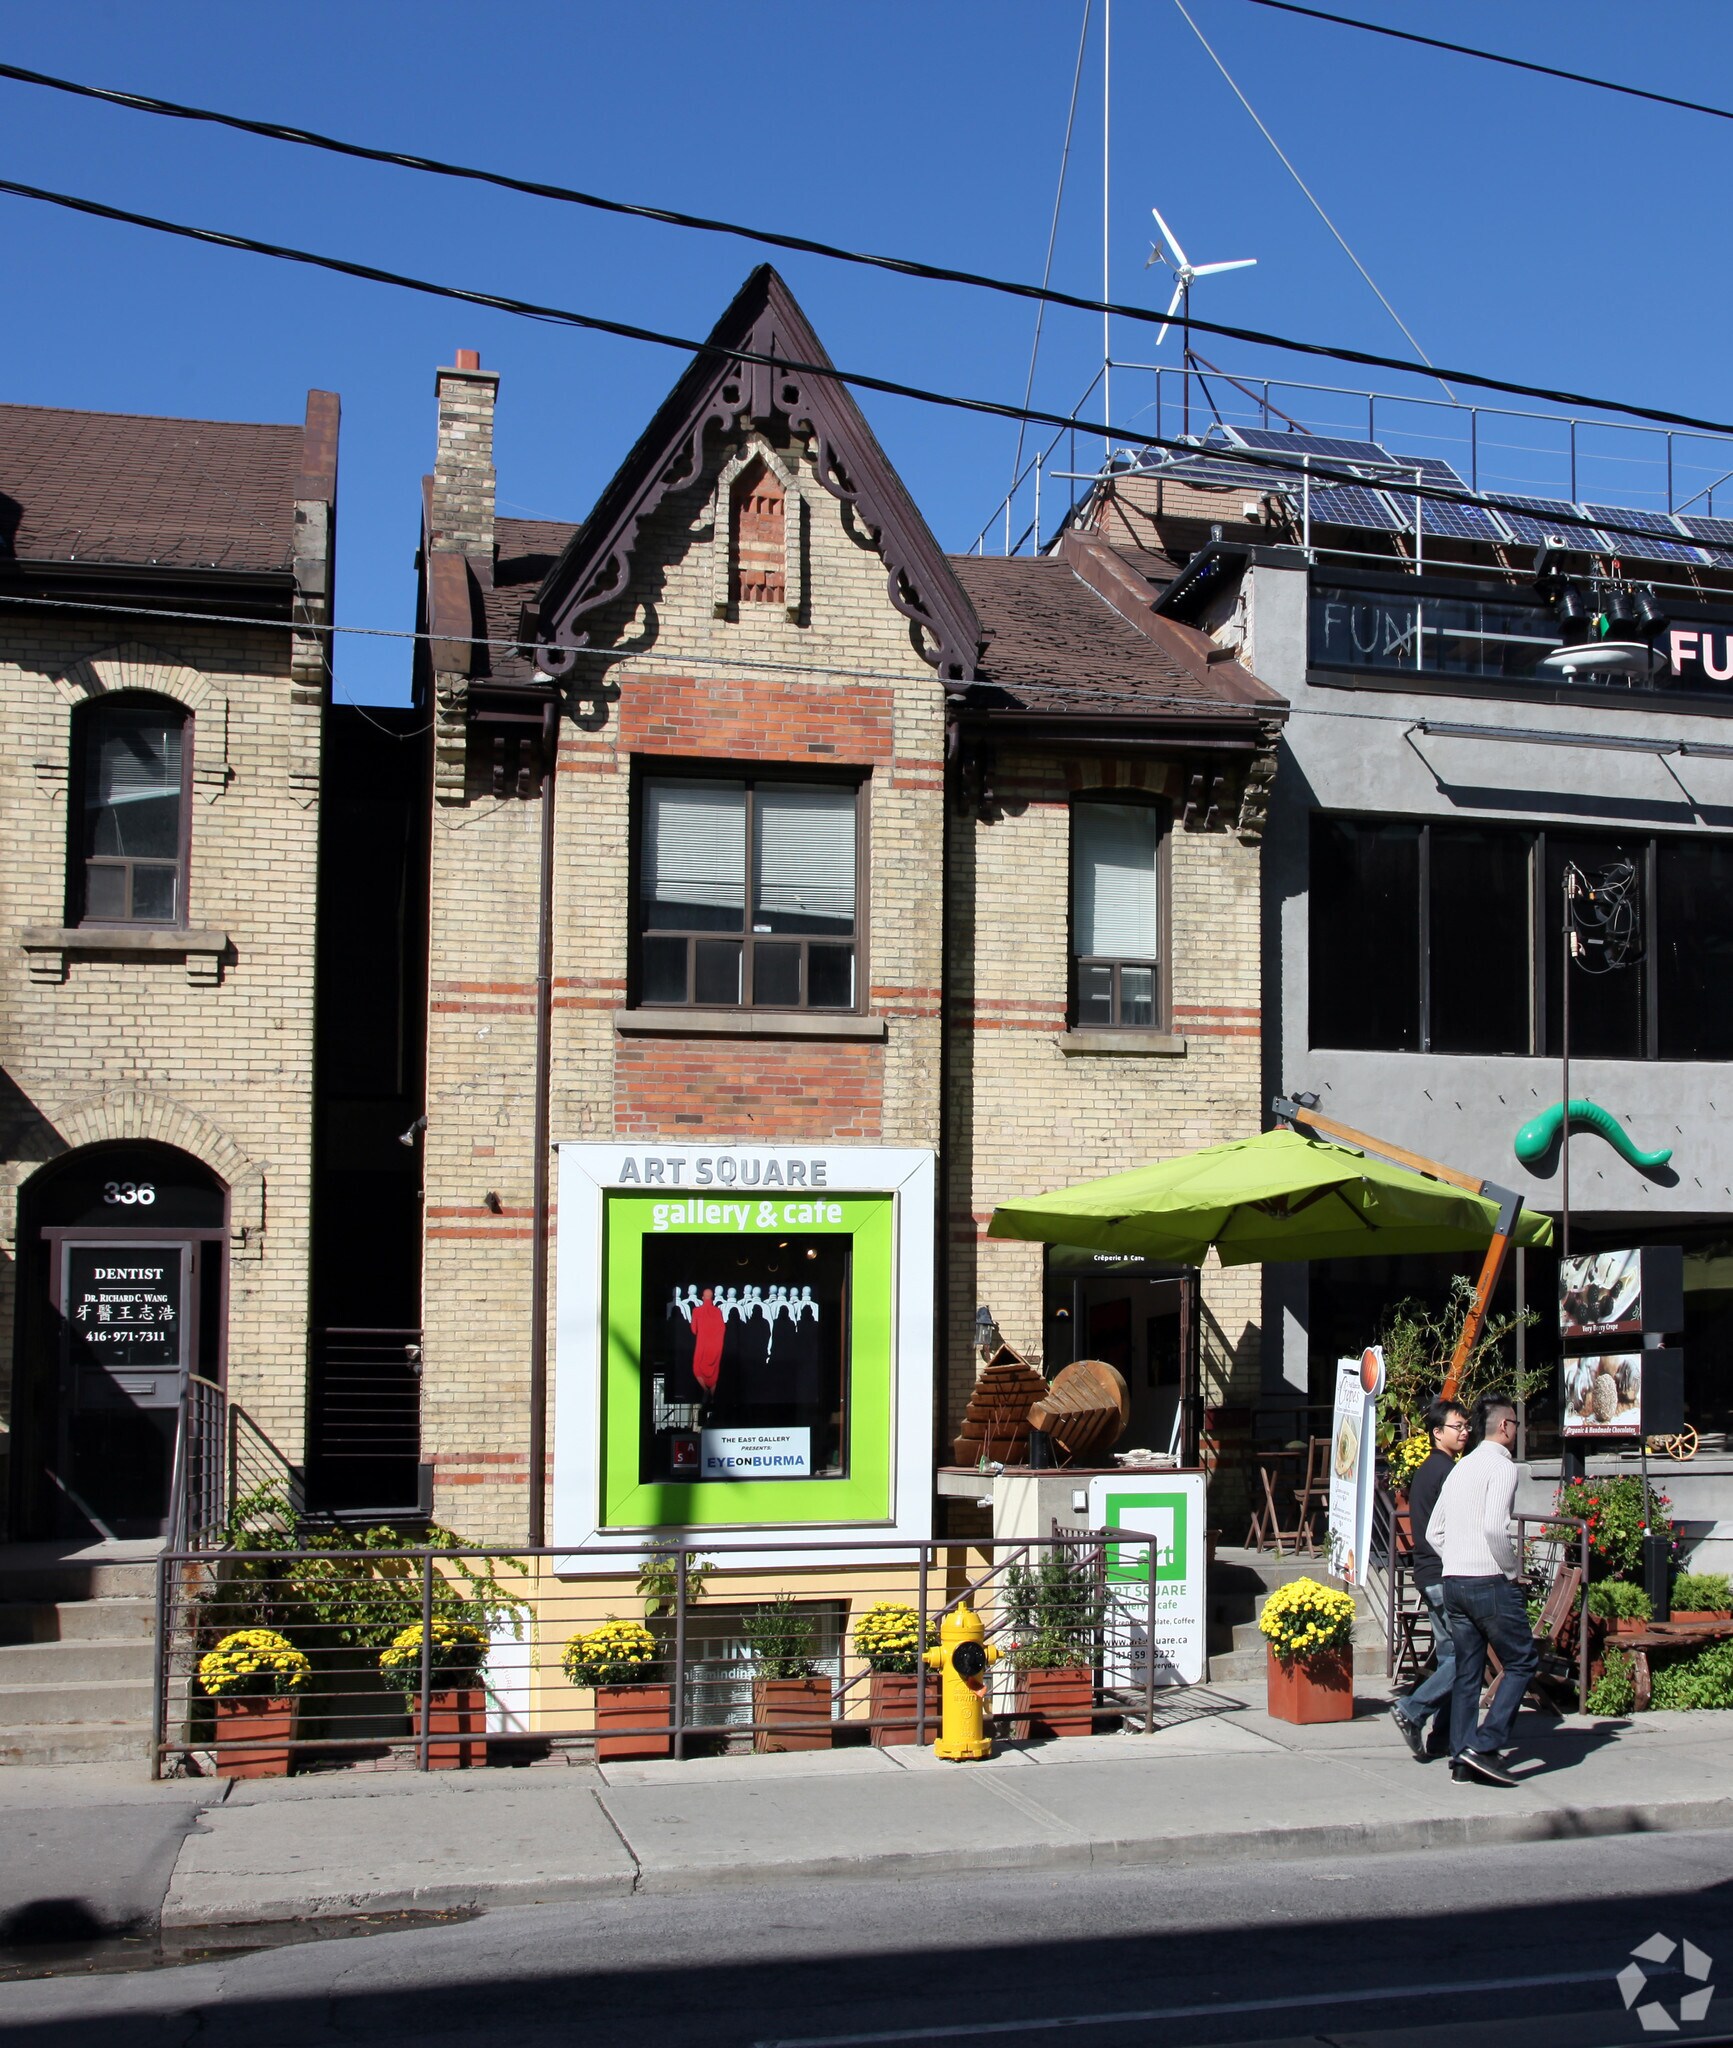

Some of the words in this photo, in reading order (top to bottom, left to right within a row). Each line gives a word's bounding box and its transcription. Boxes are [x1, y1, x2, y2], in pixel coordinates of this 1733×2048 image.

[1324, 603, 1412, 657] FUN
[618, 1156, 686, 1184] ART
[696, 1155, 827, 1186] SQUARE
[103, 1181, 156, 1205] 336
[652, 1197, 751, 1231] gallery
[756, 1201, 778, 1228] &
[783, 1198, 842, 1224] cafe
[94, 1268, 164, 1280] DENTIST
[84, 1293, 98, 1303] DR.
[99, 1293, 134, 1303] RICHARD
[135, 1293, 143, 1303] C.
[144, 1293, 168, 1303] WANG
[1567, 1426, 1585, 1435] Organic
[1612, 1426, 1636, 1434] Chocolates
[1114, 1601, 1146, 1612] gllery
[1157, 1600, 1178, 1610] cafe
[1173, 1616, 1196, 1625] Coffee
[1134, 1651, 1150, 1659] 59
